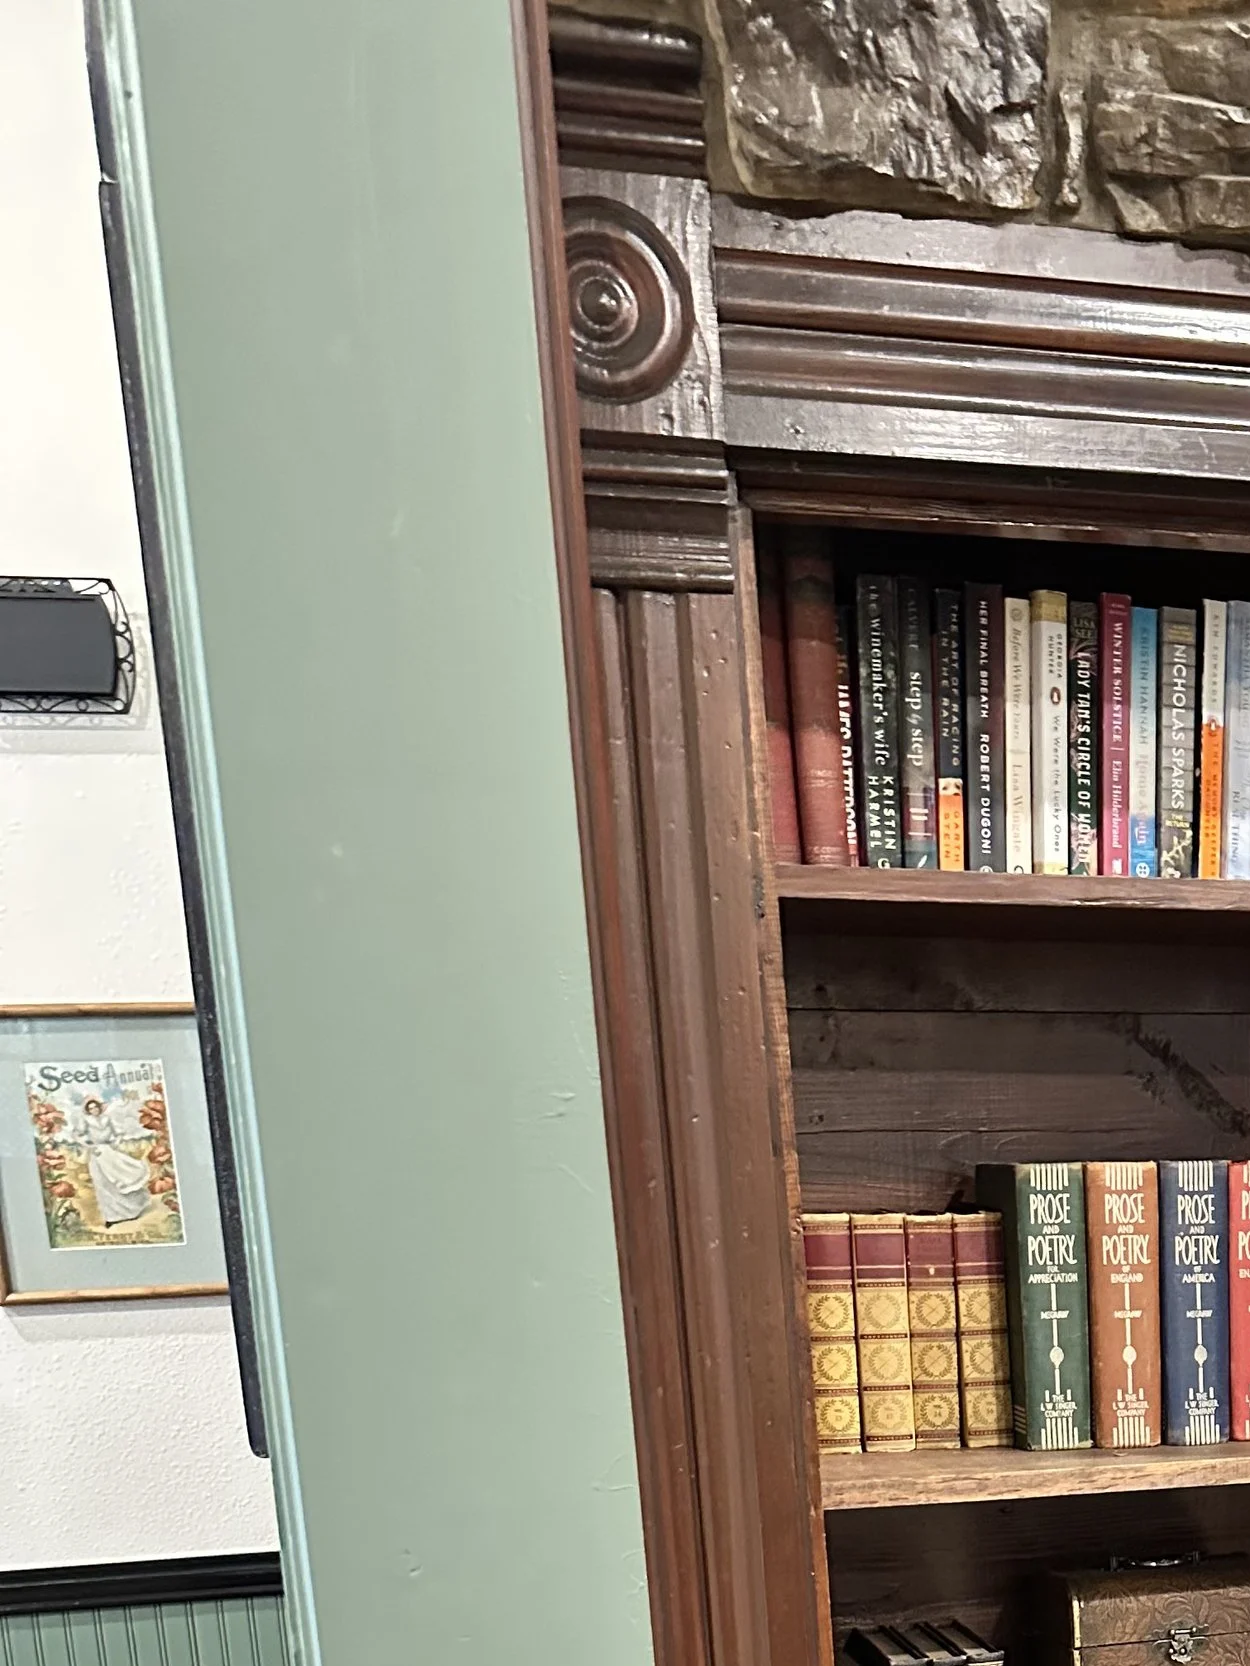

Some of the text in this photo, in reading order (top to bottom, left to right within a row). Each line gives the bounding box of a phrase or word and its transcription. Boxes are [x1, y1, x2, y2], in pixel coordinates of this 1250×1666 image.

[1073, 617, 1095, 629] LISA
[1075, 628, 1092, 639] SEE
[1009, 627, 1022, 662] Before
[1056, 633, 1064, 679] GEORGIA
[1111, 621, 1124, 675] WINTER
[867, 584, 890, 766] the winemaker's wife
[940, 630, 950, 738] IN THE RAIN
[950, 604, 960, 766] THE ART OF RACING
[1012, 664, 1022, 682] We
[1138, 628, 1149, 746] KRISTIN HANNAH
[1210, 645, 1218, 704] EDWARDS
[904, 671, 924, 711] step
[1012, 684, 1022, 709] Were
[1171, 644, 1187, 742] NICHOLAS
[1111, 679, 1125, 743] SOLSTICE
[979, 601, 992, 855] HER FINAL BREATH ROBERT DUGONI
[906, 728, 925, 767] step
[1076, 652, 1091, 866] LADY TAN'S CIRCLE OF WOMEN
[1052, 715, 1062, 853] We Were the Lucky Ones
[1171, 747, 1187, 810] SPARKS
[867, 775, 882, 849] HARMEL
[882, 775, 897, 850] KRISTIN
[1009, 764, 1023, 853] Lisa Wingate
[1111, 759, 1123, 849] Elin Hilderbrand
[943, 812, 951, 859] STEIN
[952, 810, 961, 862] GARTH
[37, 1062, 154, 1092] Seed Annual
[1029, 1192, 1072, 1225] PROSE
[1104, 1192, 1145, 1224] PROSE
[1177, 1194, 1216, 1225] PROSE
[1042, 1224, 1060, 1234] AND
[1117, 1224, 1135, 1234] AND
[1189, 1225, 1206, 1235] AND
[1027, 1234, 1078, 1266] POETRY
[1101, 1234, 1151, 1266] POETRY
[1174, 1234, 1221, 1266] POETRY
[1028, 1272, 1078, 1284] APPRECIATION
[1046, 1265, 1060, 1273] FOR
[1110, 1272, 1144, 1283] ENGLAND
[1121, 1265, 1131, 1273] OF
[1182, 1272, 1216, 1284] AMERICA
[1193, 1265, 1202, 1273] OF
[1044, 1409, 1074, 1418] COMPANY
[1116, 1408, 1146, 1417] COMPANY
[1189, 1407, 1216, 1416] COMPANY
